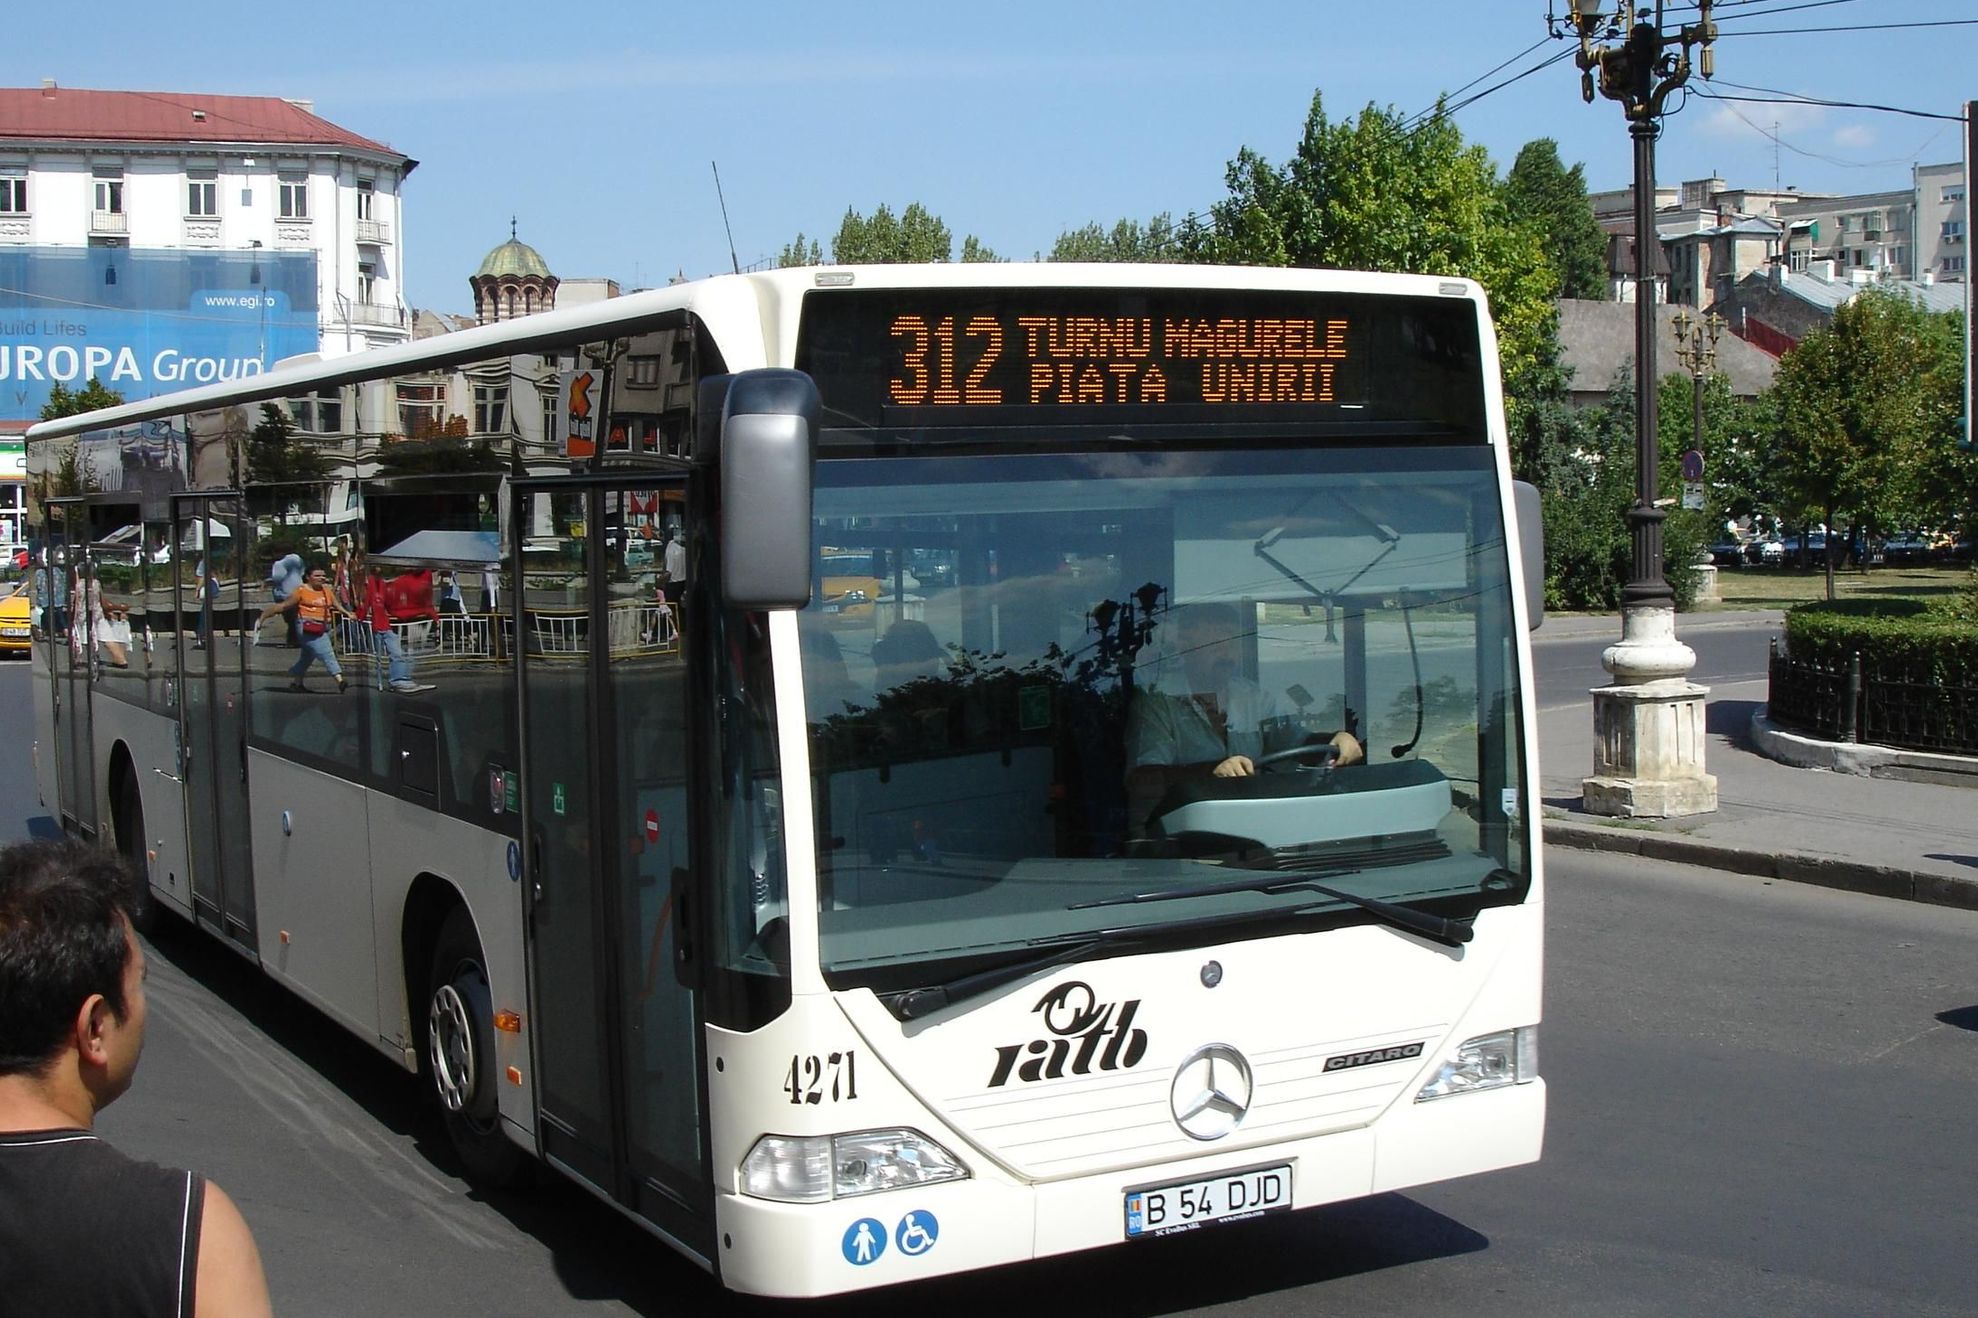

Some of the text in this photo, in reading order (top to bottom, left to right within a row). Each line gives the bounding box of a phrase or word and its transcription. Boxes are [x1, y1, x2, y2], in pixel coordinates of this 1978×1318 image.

[0, 319, 88, 336] uild Lifes
[1018, 316, 1348, 359] TURNU MAGURELE
[890, 316, 1002, 404] 312
[1031, 363, 1335, 403] PIATA UNIRII
[783, 1050, 858, 1105] 4271
[1327, 1044, 1421, 1069] CITARO
[1147, 1193, 1166, 1225] B
[1180, 1186, 1212, 1219] 54
[1228, 1174, 1281, 1211] DJD
